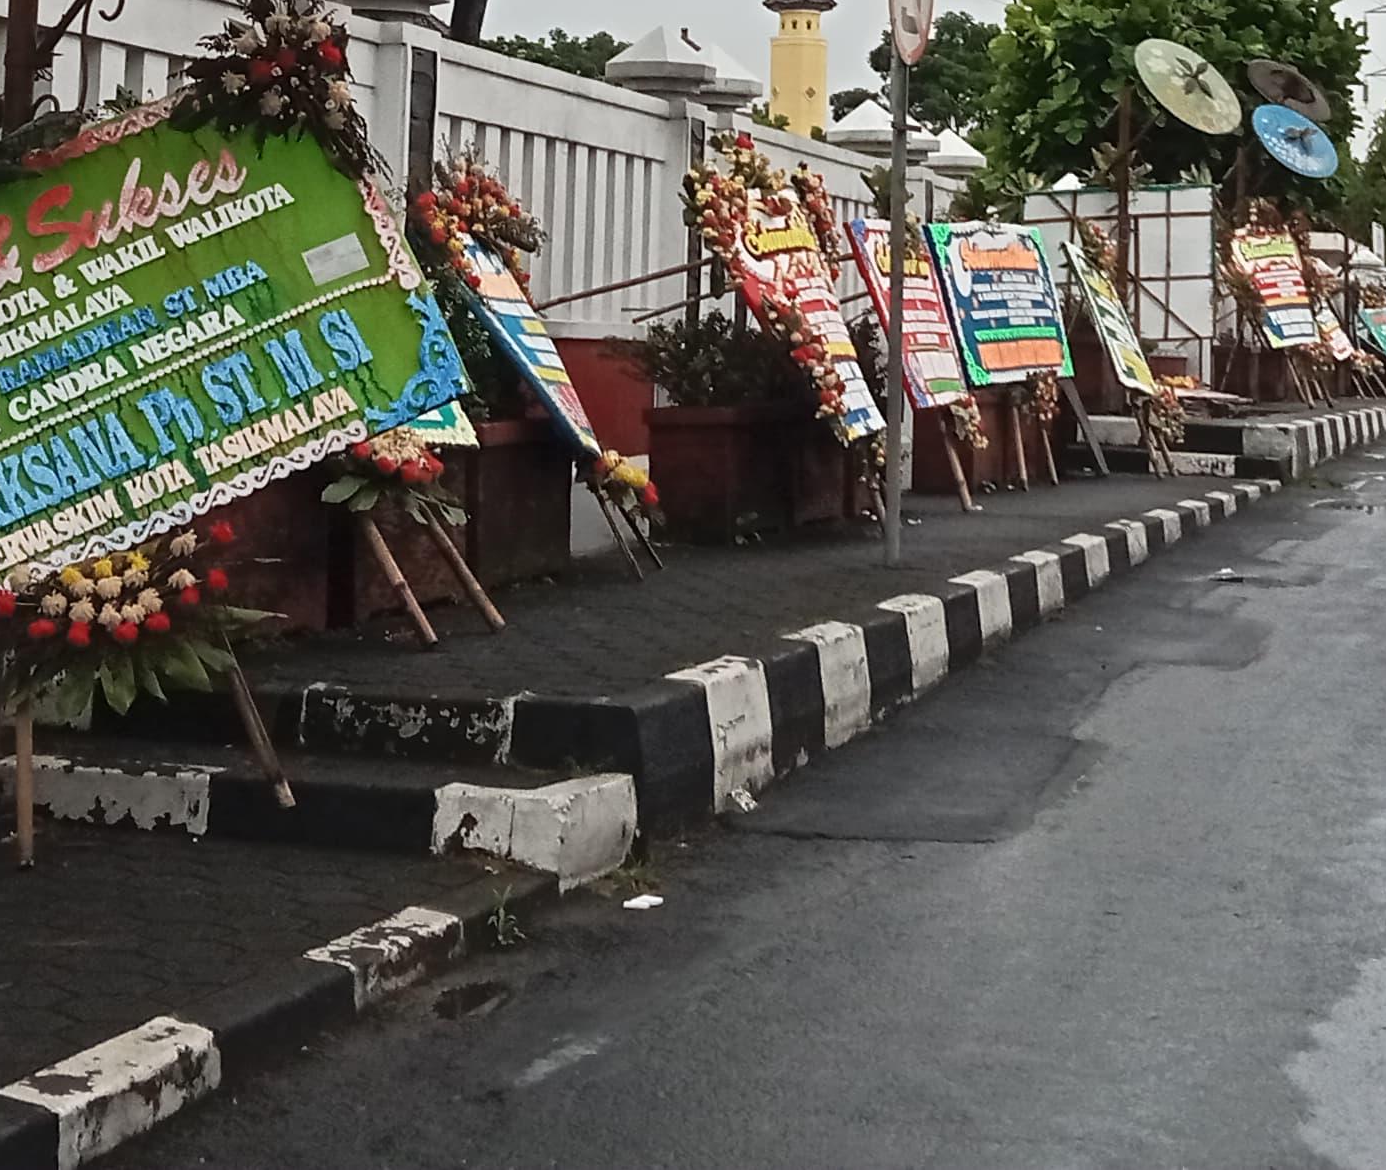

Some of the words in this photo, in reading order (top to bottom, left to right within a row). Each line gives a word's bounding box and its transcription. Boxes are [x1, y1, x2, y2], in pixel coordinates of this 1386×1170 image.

[26, 149, 247, 273] Sukses
[53, 273, 79, 300] &
[77, 234, 166, 286] WAKIL
[165, 182, 295, 249] WALIKOTA
[202, 258, 269, 303] MBA
[7, 354, 129, 423] CANDRA
[128, 303, 247, 370] NEGARA
[122, 459, 196, 509] KOTA
[192, 386, 358, 477] TASIKMALAYA
